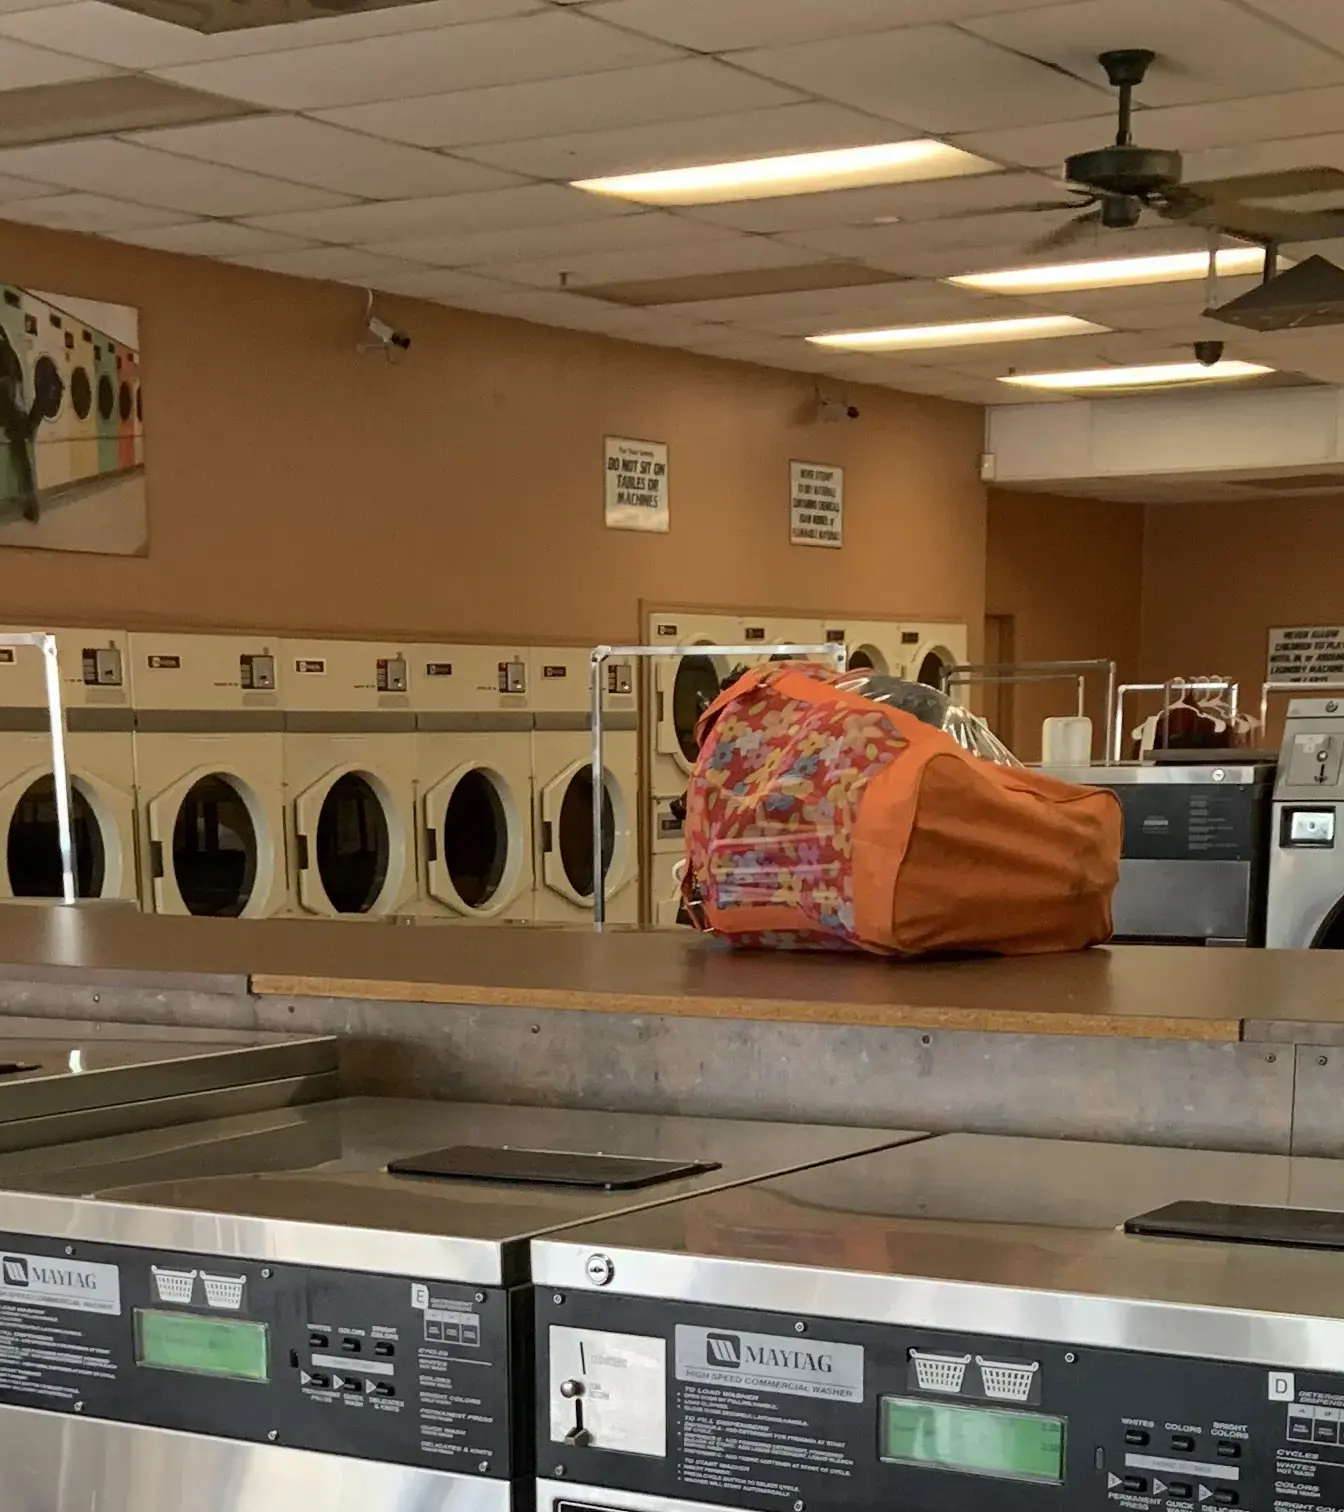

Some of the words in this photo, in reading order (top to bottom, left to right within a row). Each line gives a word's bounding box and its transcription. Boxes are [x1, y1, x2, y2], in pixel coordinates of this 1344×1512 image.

[608, 457, 619, 470] DO
[622, 459, 637, 472] NOT
[640, 461, 651, 474] SIT
[617, 474, 645, 490] TABLES
[32, 1267, 97, 1289] MAYTAG
[417, 1290, 424, 1303] E
[744, 1345, 832, 1373] MAYTAG
[712, 1373, 742, 1384] SPEED
[744, 1377, 809, 1392] COMMERCIAL
[812, 1386, 853, 1397] WASHER
[1276, 1379, 1287, 1393] D
[1121, 1417, 1155, 1428] WHITES
[1164, 1422, 1202, 1434] COLORS
[1213, 1422, 1248, 1432] BRIGHT
[1210, 1429, 1249, 1439] COLORS
[1276, 1449, 1319, 1460] CYCLES
[1275, 1481, 1320, 1492] COLORS
[1108, 1492, 1162, 1505] PERMANENT
[1119, 1500, 1150, 1511] PRESS
[1166, 1500, 1194, 1510] QUICK
[1274, 1500, 1314, 1510] BRIGHT
